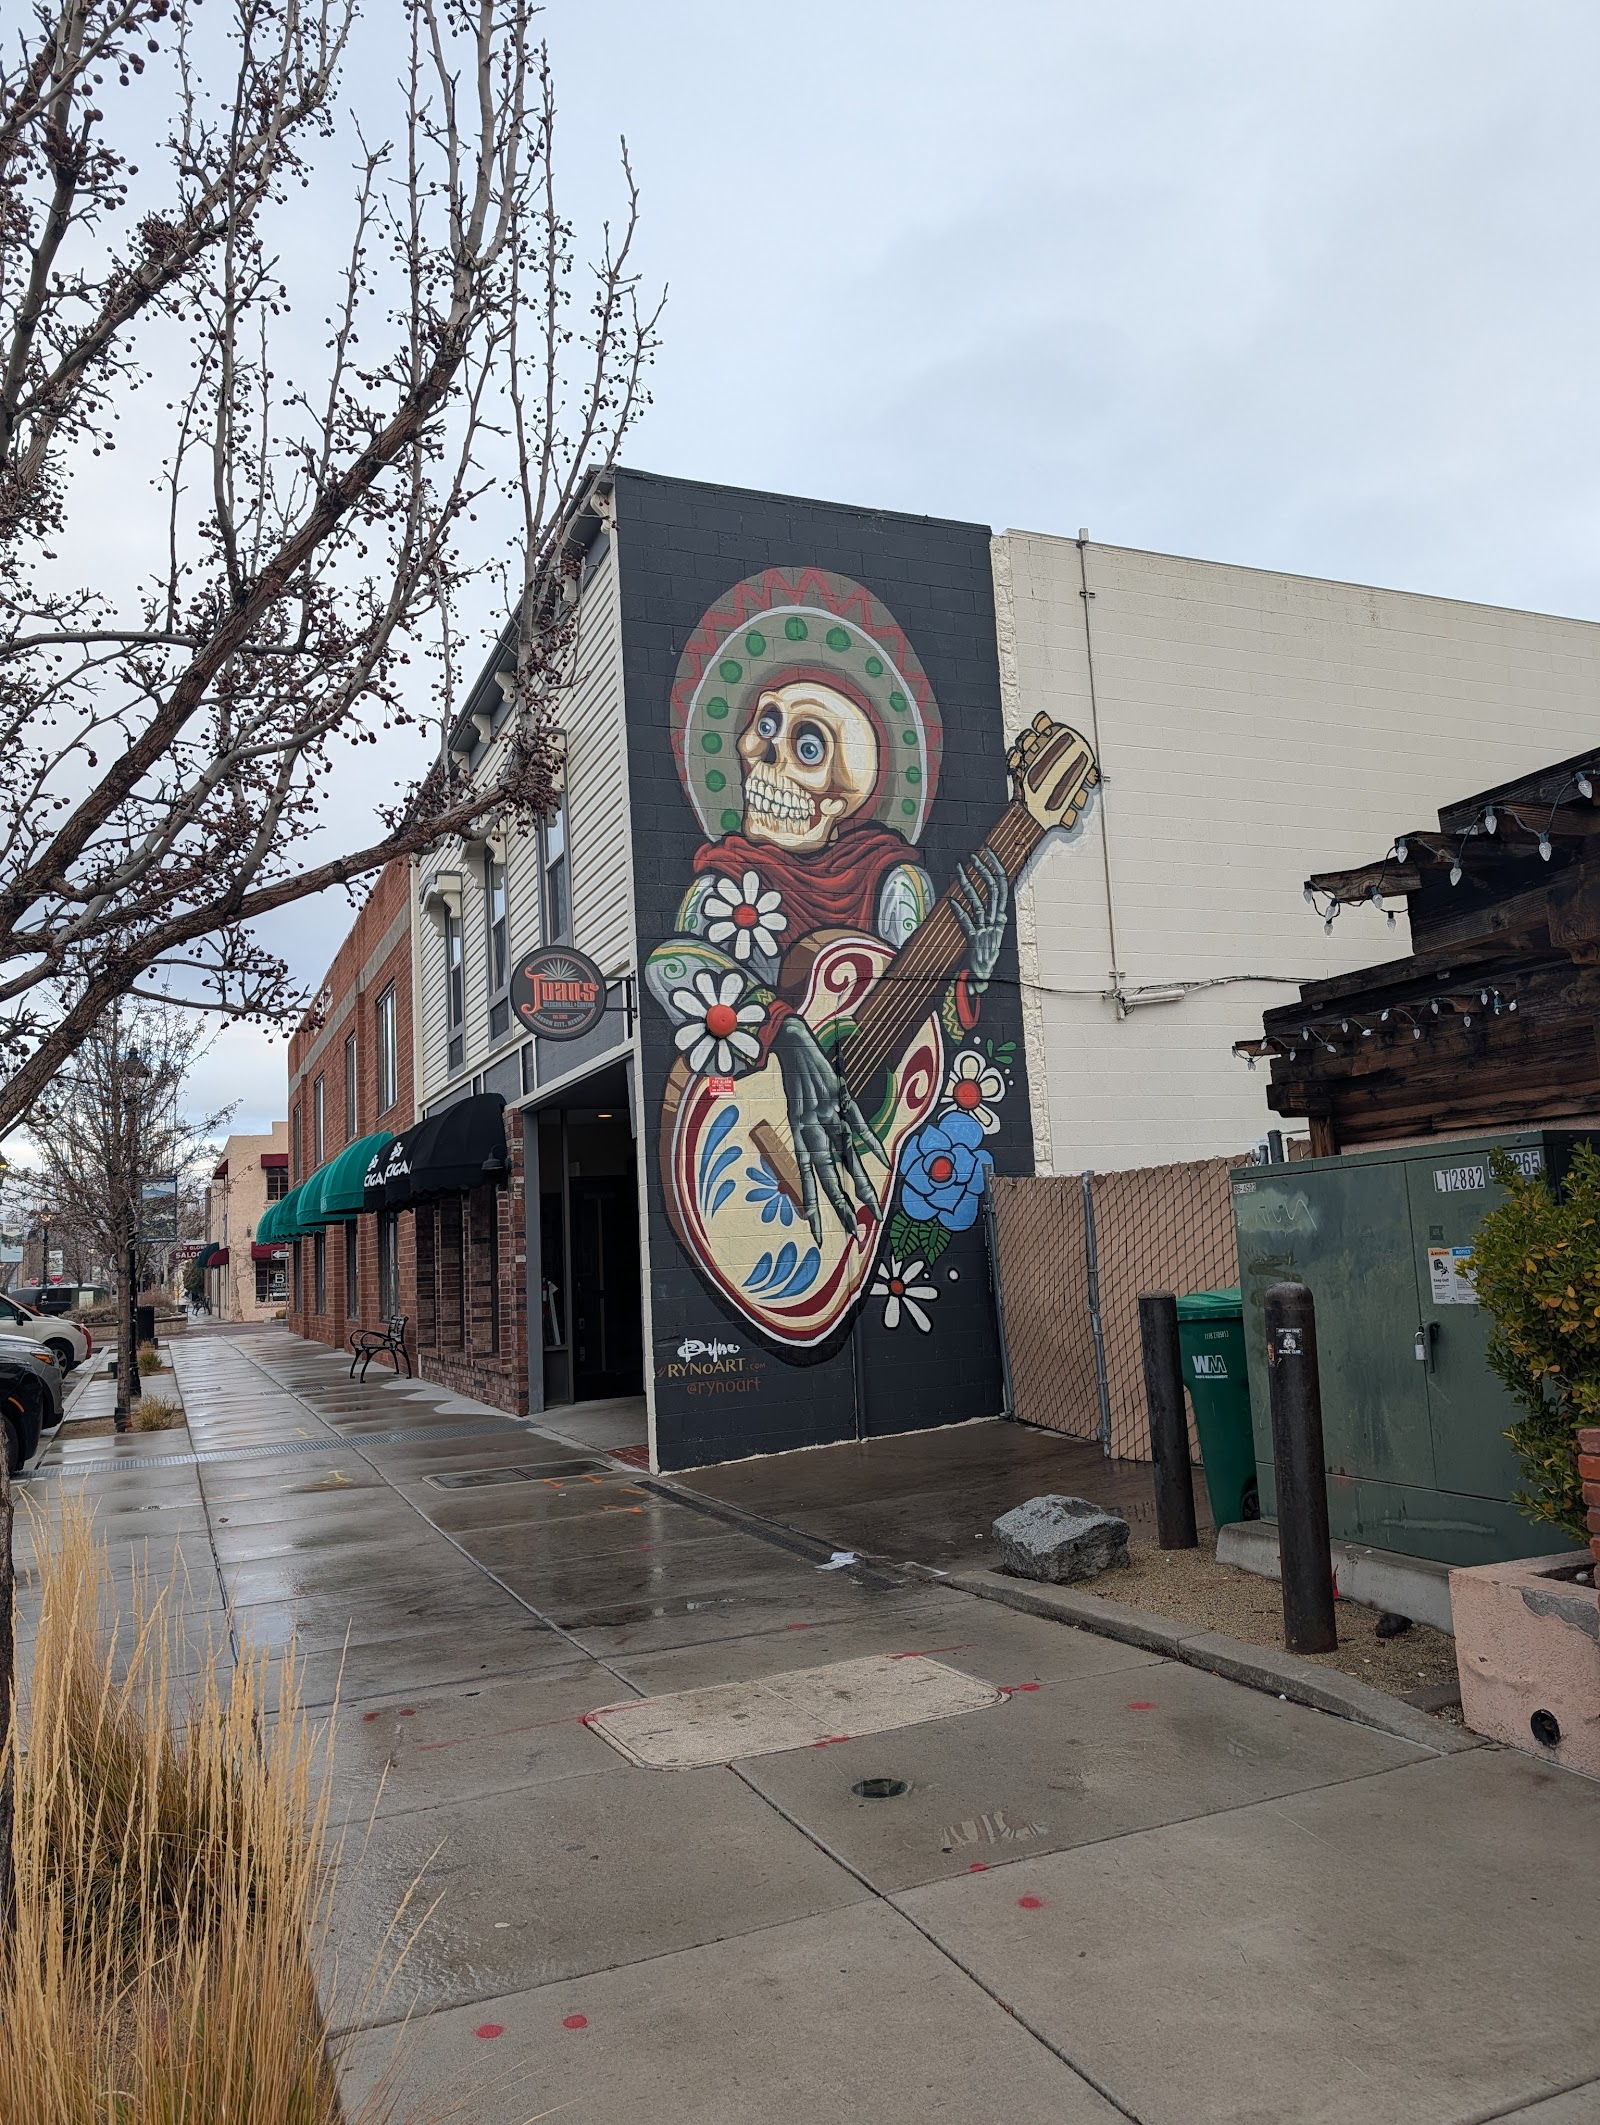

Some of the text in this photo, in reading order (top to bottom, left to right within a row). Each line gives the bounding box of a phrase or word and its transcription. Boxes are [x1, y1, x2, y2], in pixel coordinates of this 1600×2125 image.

[521, 967, 599, 1014] Juan's
[386, 1160, 412, 1178] CIGA
[364, 1171, 388, 1188] CIGA
[1191, 1354, 1227, 1373] WM
[686, 1376, 761, 1397] @rynoart
